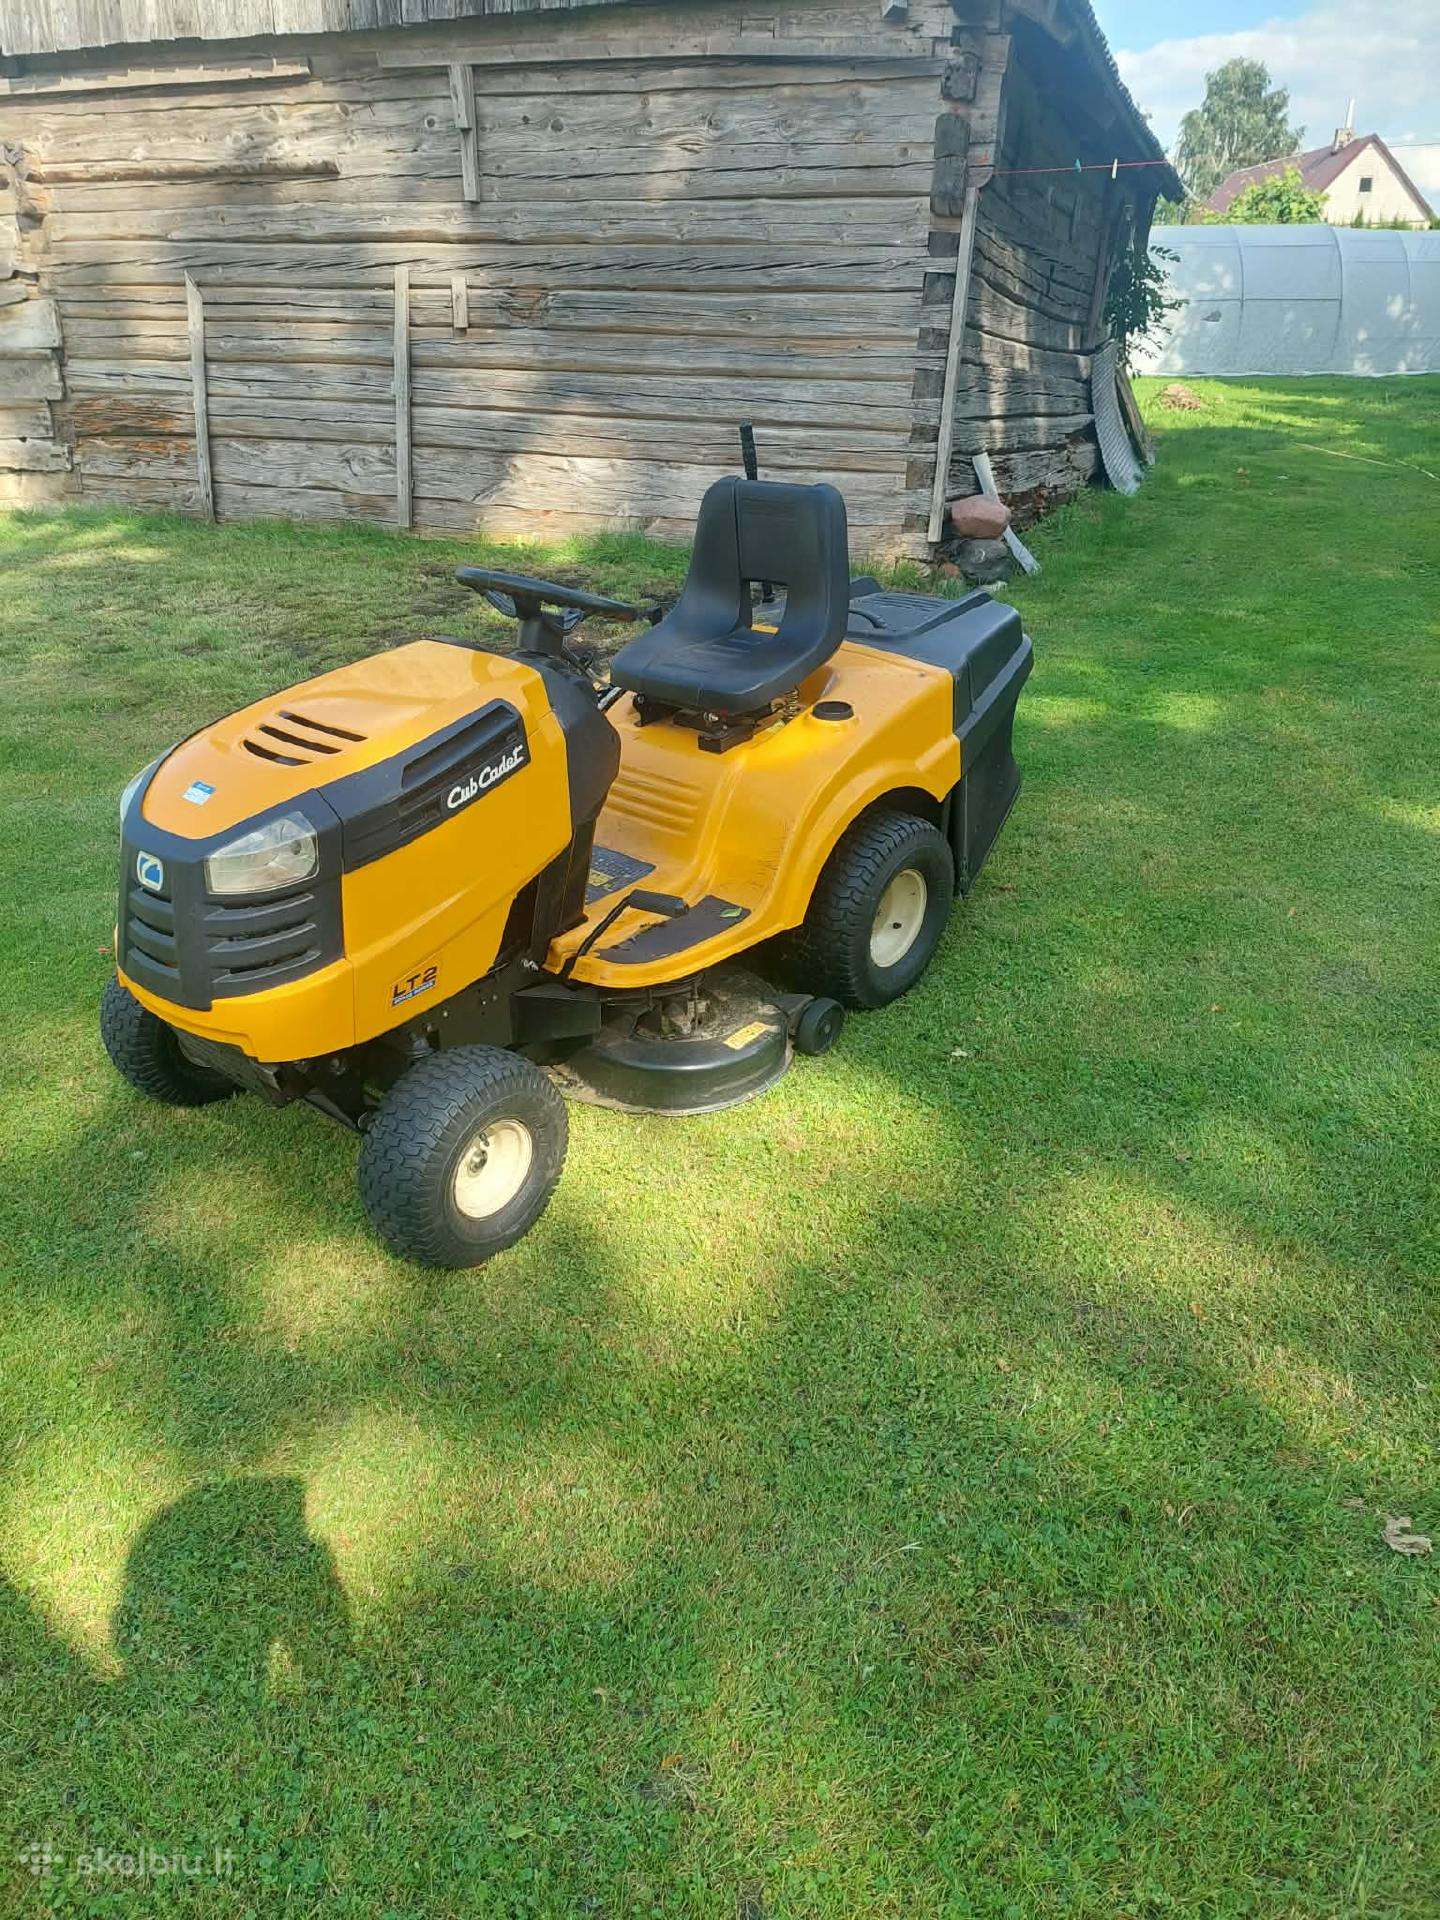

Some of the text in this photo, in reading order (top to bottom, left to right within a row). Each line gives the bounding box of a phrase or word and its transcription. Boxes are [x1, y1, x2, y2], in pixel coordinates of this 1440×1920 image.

[447, 744, 524, 808] Cub Cadet
[393, 966, 437, 998] LT2
